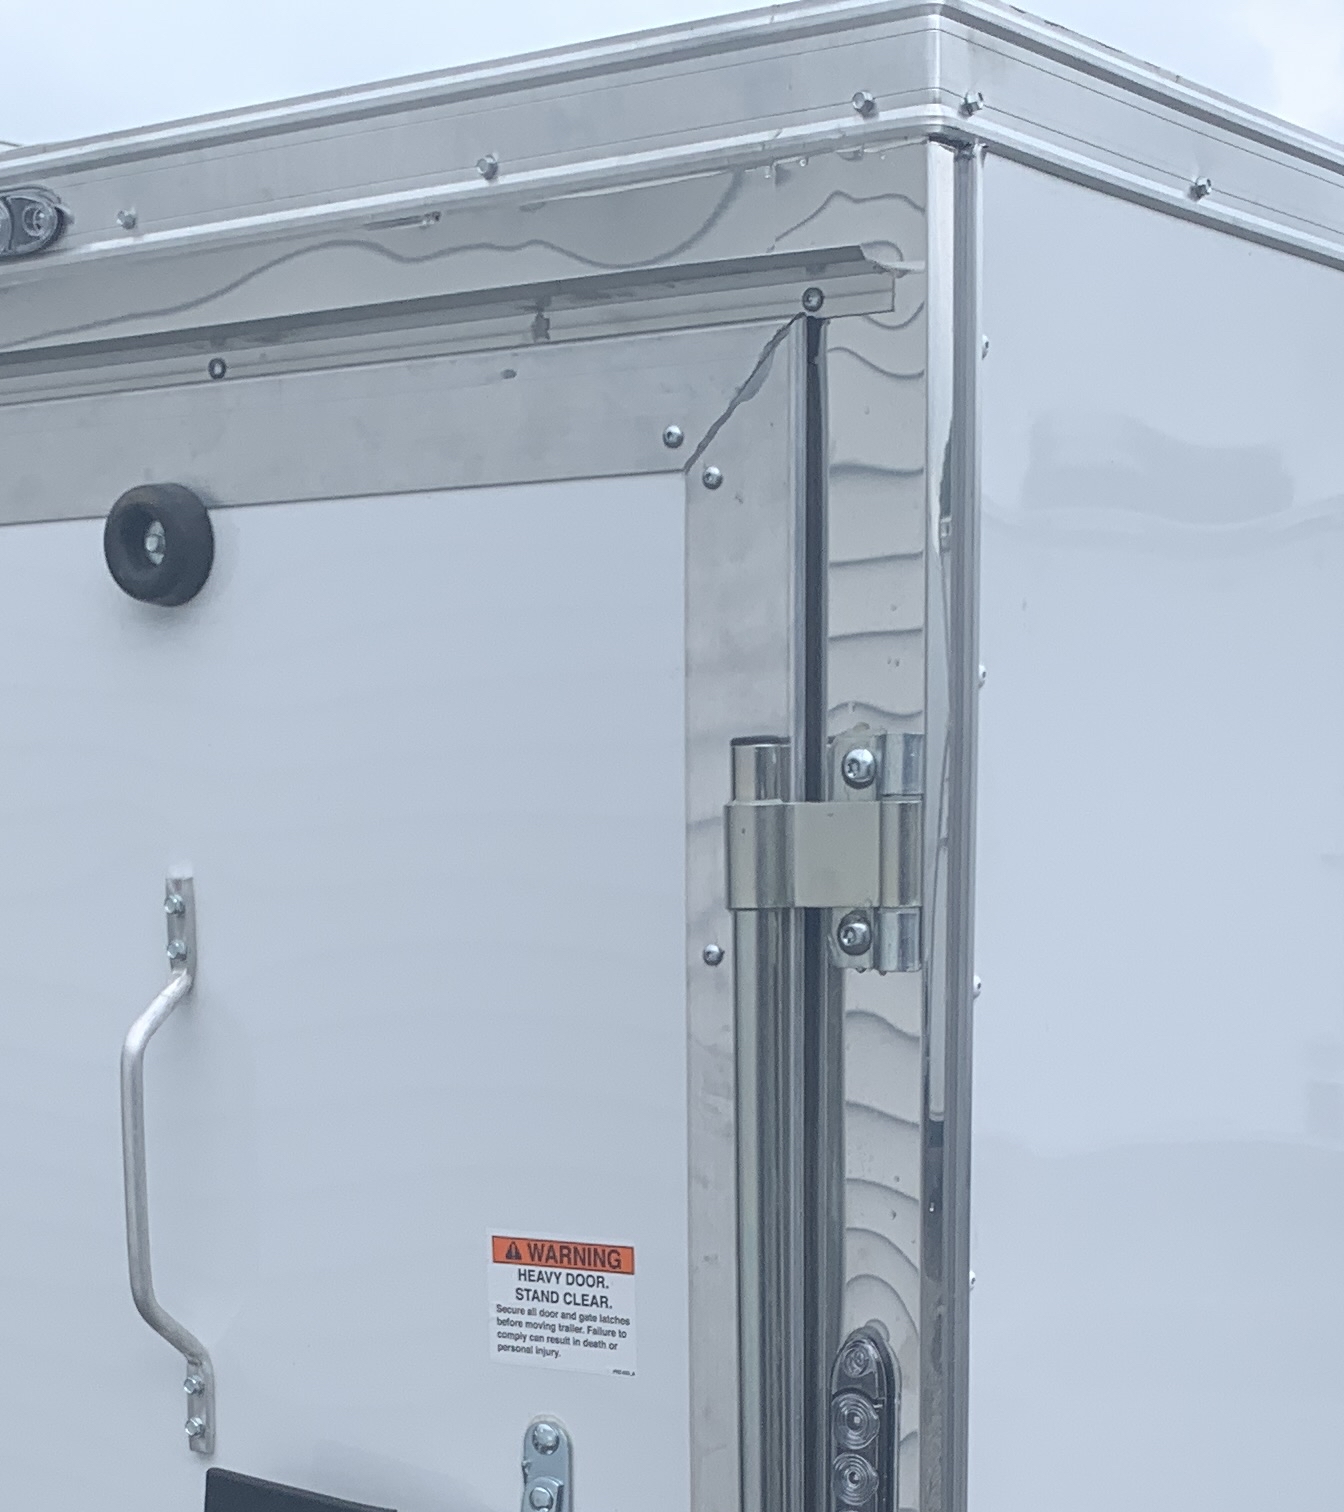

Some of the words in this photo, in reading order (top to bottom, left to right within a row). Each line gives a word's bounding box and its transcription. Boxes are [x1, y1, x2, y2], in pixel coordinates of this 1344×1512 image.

[527, 1243, 622, 1270] WARNING
[518, 1268, 562, 1285] HEAVY
[565, 1272, 609, 1289] DOOR.
[515, 1287, 560, 1304] STAND
[563, 1291, 613, 1309] CLEAR.
[496, 1303, 526, 1315] Secure
[527, 1307, 537, 1315] all
[539, 1308, 559, 1319] door
[560, 1311, 577, 1320] and
[578, 1313, 598, 1323] gate
[599, 1314, 631, 1326] latches
[496, 1316, 523, 1328] before
[525, 1321, 556, 1333] moving
[558, 1322, 585, 1335] trailer.
[587, 1325, 616, 1338] Failure
[618, 1329, 628, 1339] to
[497, 1330, 527, 1343] comply
[529, 1333, 545, 1342] can
[546, 1335, 571, 1345] result
[572, 1336, 581, 1346] in
[583, 1338, 607, 1349] death
[608, 1342, 618, 1350] or
[497, 1343, 533, 1354] personal
[536, 1346, 561, 1359] injury.
